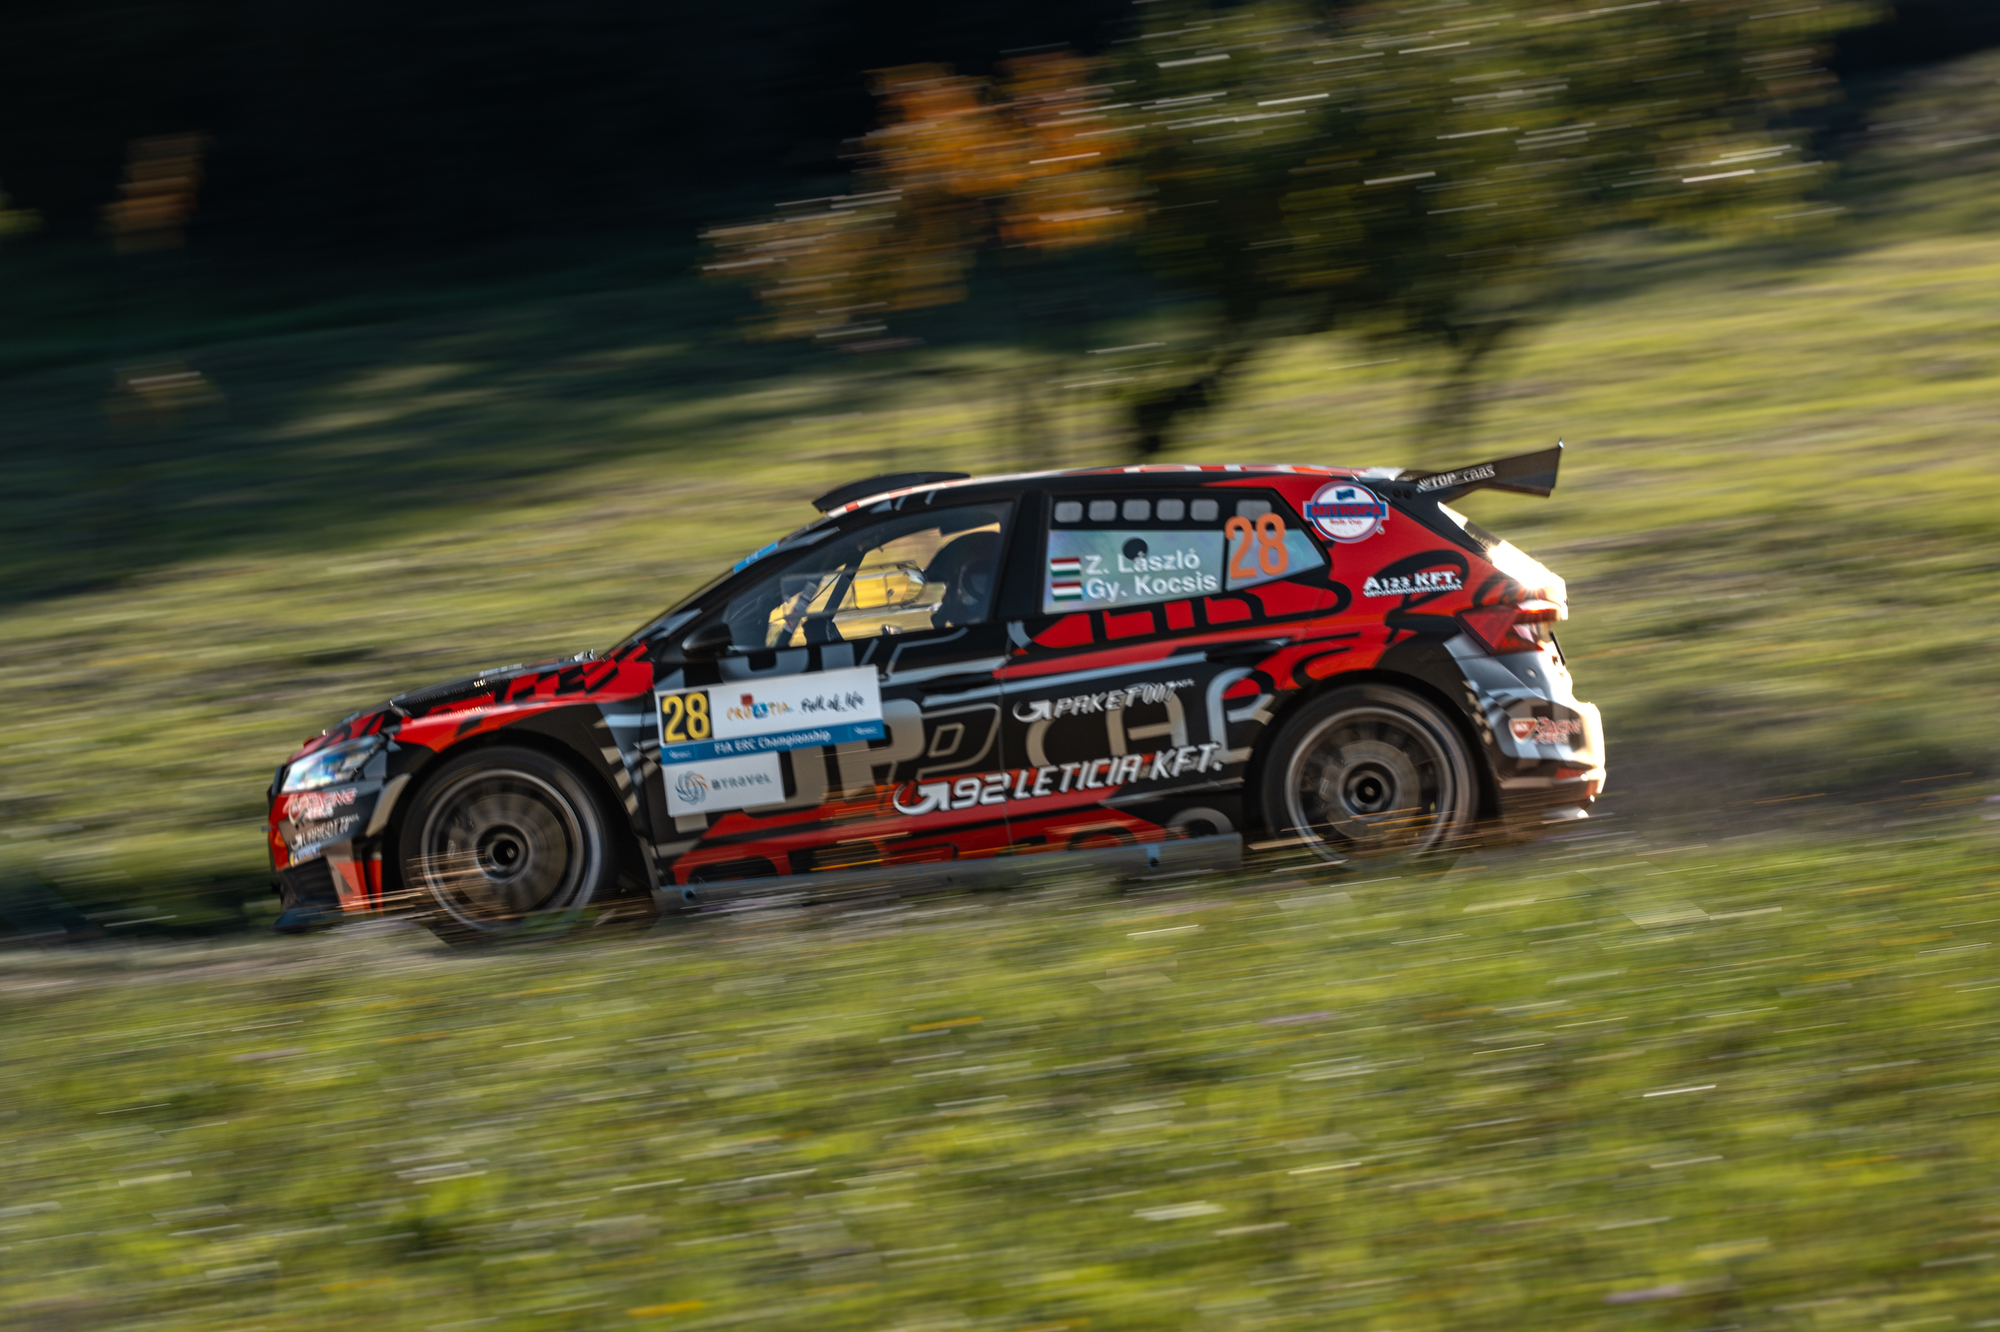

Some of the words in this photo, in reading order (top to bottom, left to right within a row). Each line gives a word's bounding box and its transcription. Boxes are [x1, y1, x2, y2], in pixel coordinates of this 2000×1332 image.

[1431, 472, 1457, 487] TOP
[1463, 465, 1495, 482] CARS
[1311, 504, 1382, 517] MITROPA
[1224, 512, 1289, 580] 28
[1085, 554, 1110, 576] Z.
[1117, 548, 1201, 574] László
[1085, 577, 1128, 603] Gy.
[1134, 571, 1218, 596] Kocsis
[1363, 576, 1411, 590] A123
[1414, 571, 1463, 587] KFT.
[662, 692, 711, 743] 28
[757, 729, 832, 749] Championship
[1150, 741, 1223, 780] KFT.
